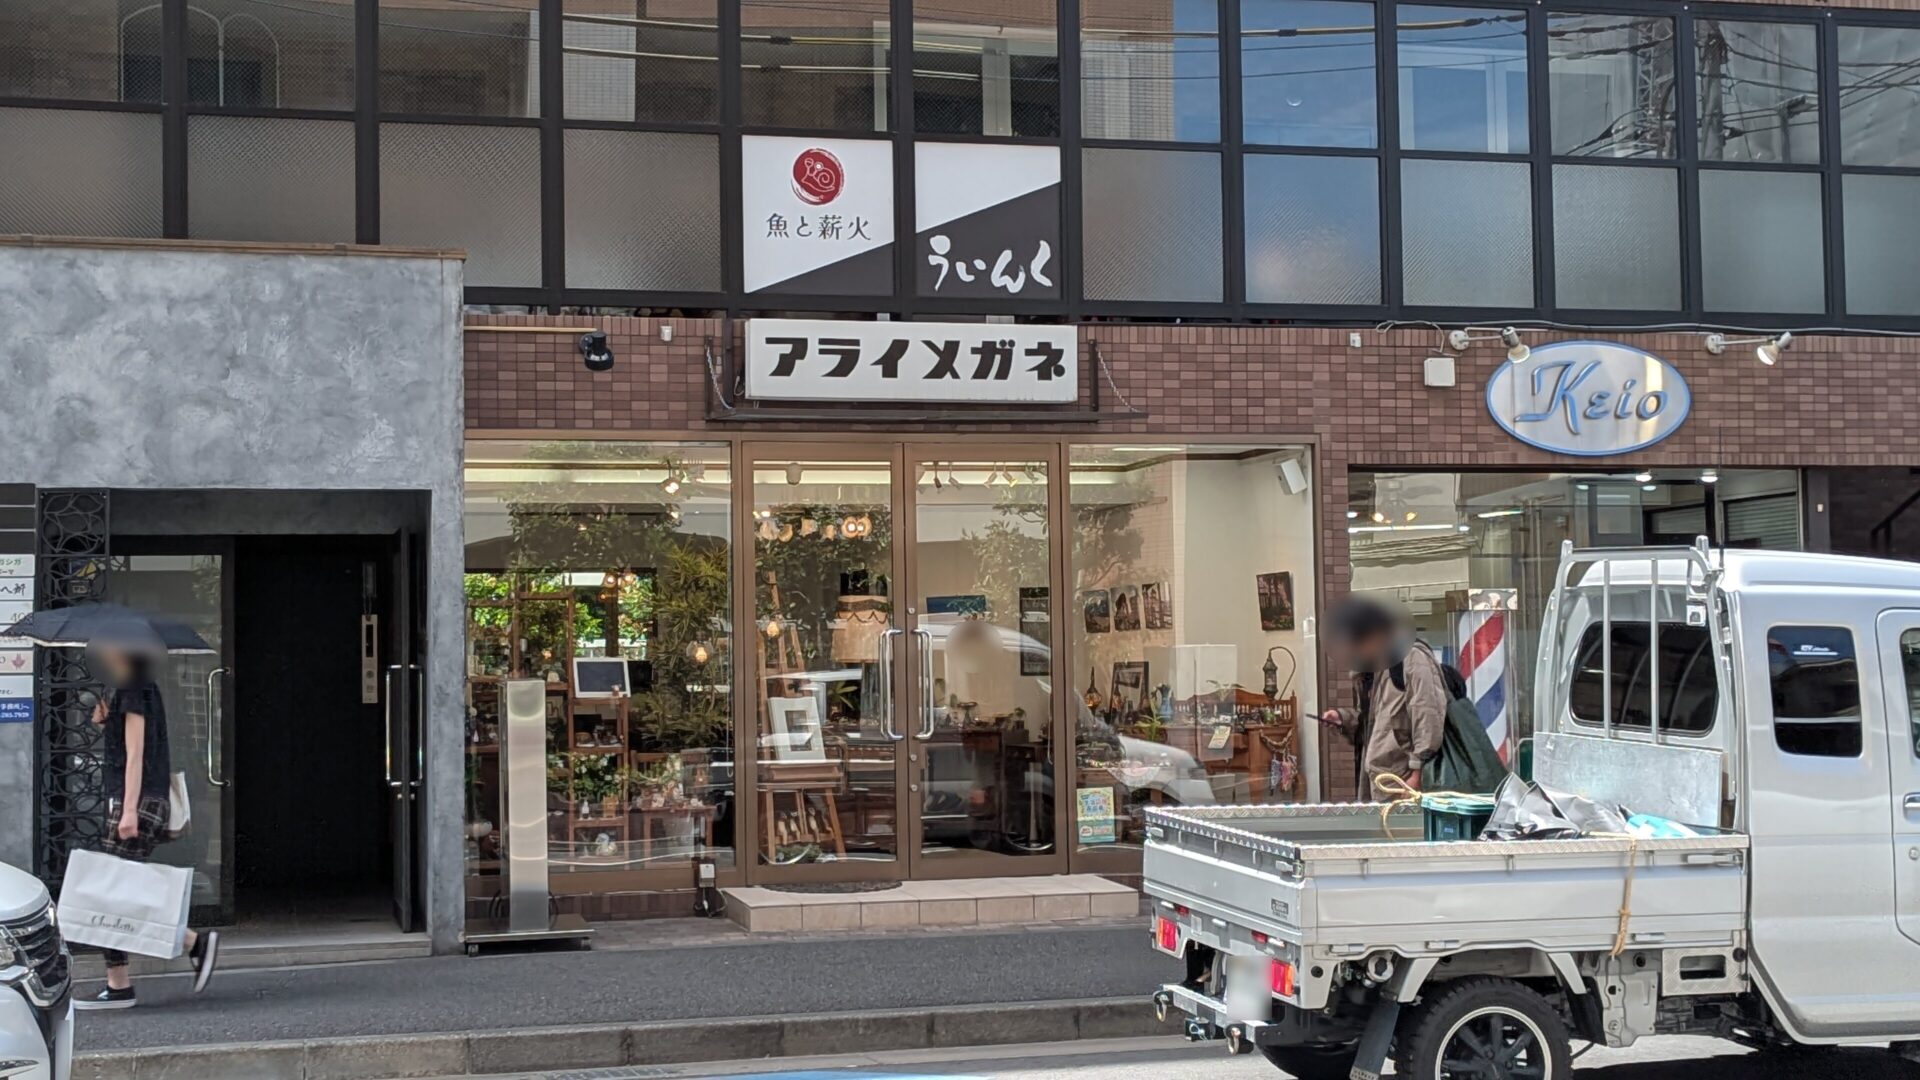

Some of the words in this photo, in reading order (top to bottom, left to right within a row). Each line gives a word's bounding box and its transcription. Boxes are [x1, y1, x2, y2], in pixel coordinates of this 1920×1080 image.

[766, 213, 872, 241] 魚と薪火
[764, 336, 1066, 382] アライメガネ
[1513, 360, 1668, 436] Keio
